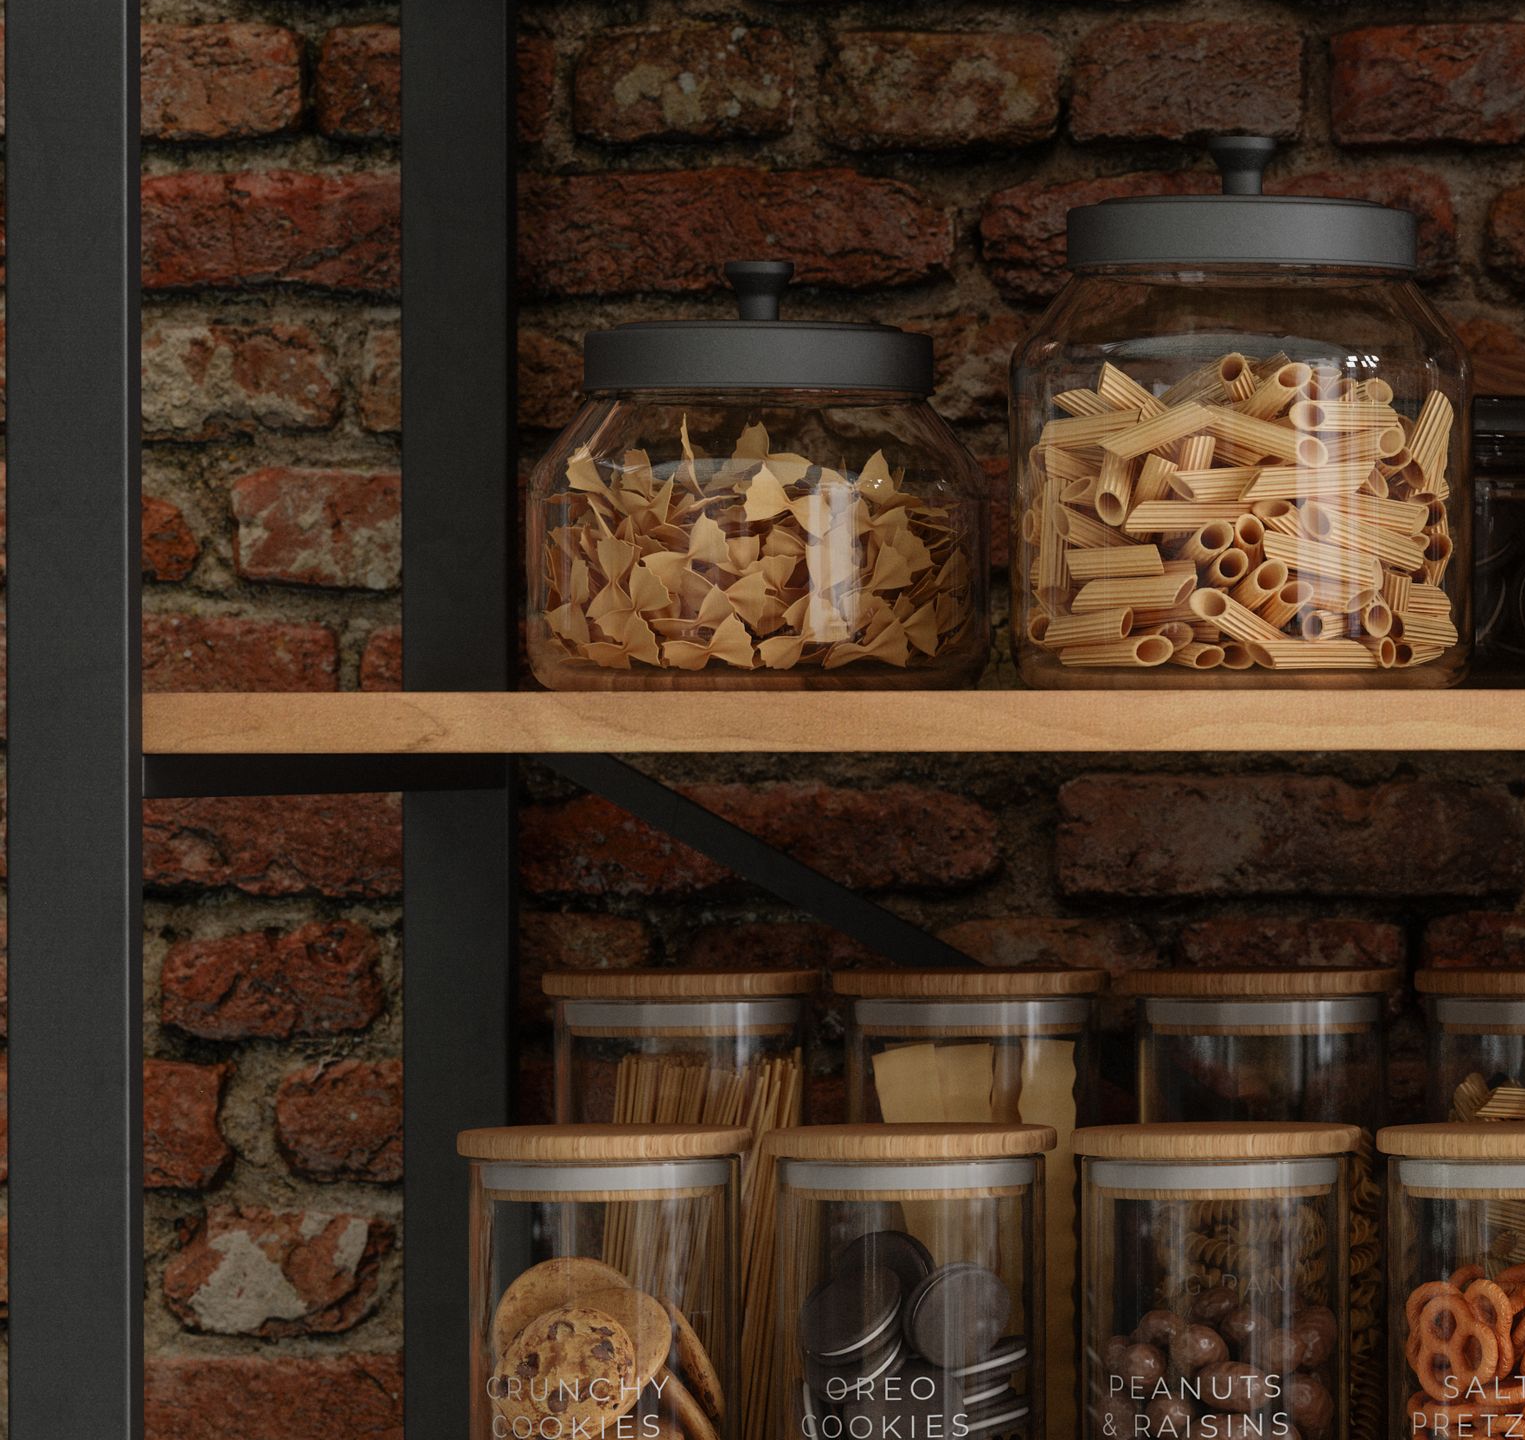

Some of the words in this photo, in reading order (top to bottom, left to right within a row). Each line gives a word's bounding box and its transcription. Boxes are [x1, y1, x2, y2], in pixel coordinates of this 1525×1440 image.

[486, 1375, 669, 1402] CRUNCHY
[826, 1376, 936, 1401] OREO
[1110, 1374, 1282, 1400] PEANUTS
[491, 1413, 661, 1440] COOKIES
[801, 1413, 970, 1440] COOKIES
[1102, 1413, 1118, 1437] &
[1133, 1412, 1290, 1438] RAISINS
